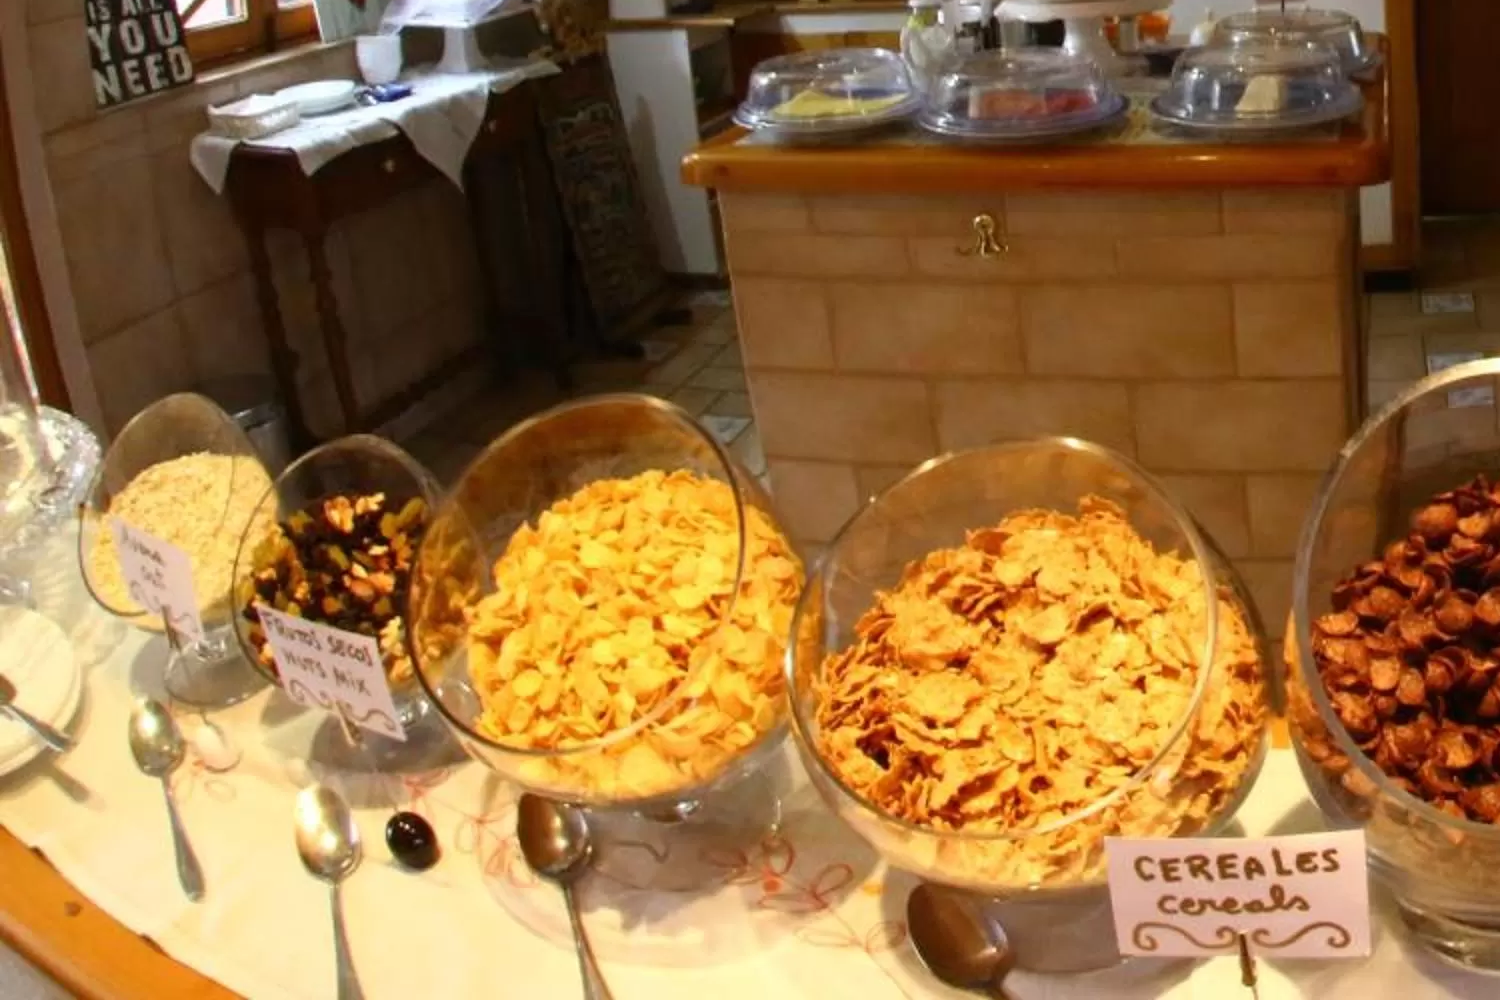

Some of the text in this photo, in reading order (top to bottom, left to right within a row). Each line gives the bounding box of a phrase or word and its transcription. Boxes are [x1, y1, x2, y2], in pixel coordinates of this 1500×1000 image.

[86, 0, 111, 22] IS
[87, 11, 178, 62] YOU
[92, 46, 193, 105] NEED
[1133, 847, 1341, 882] CEREALES
